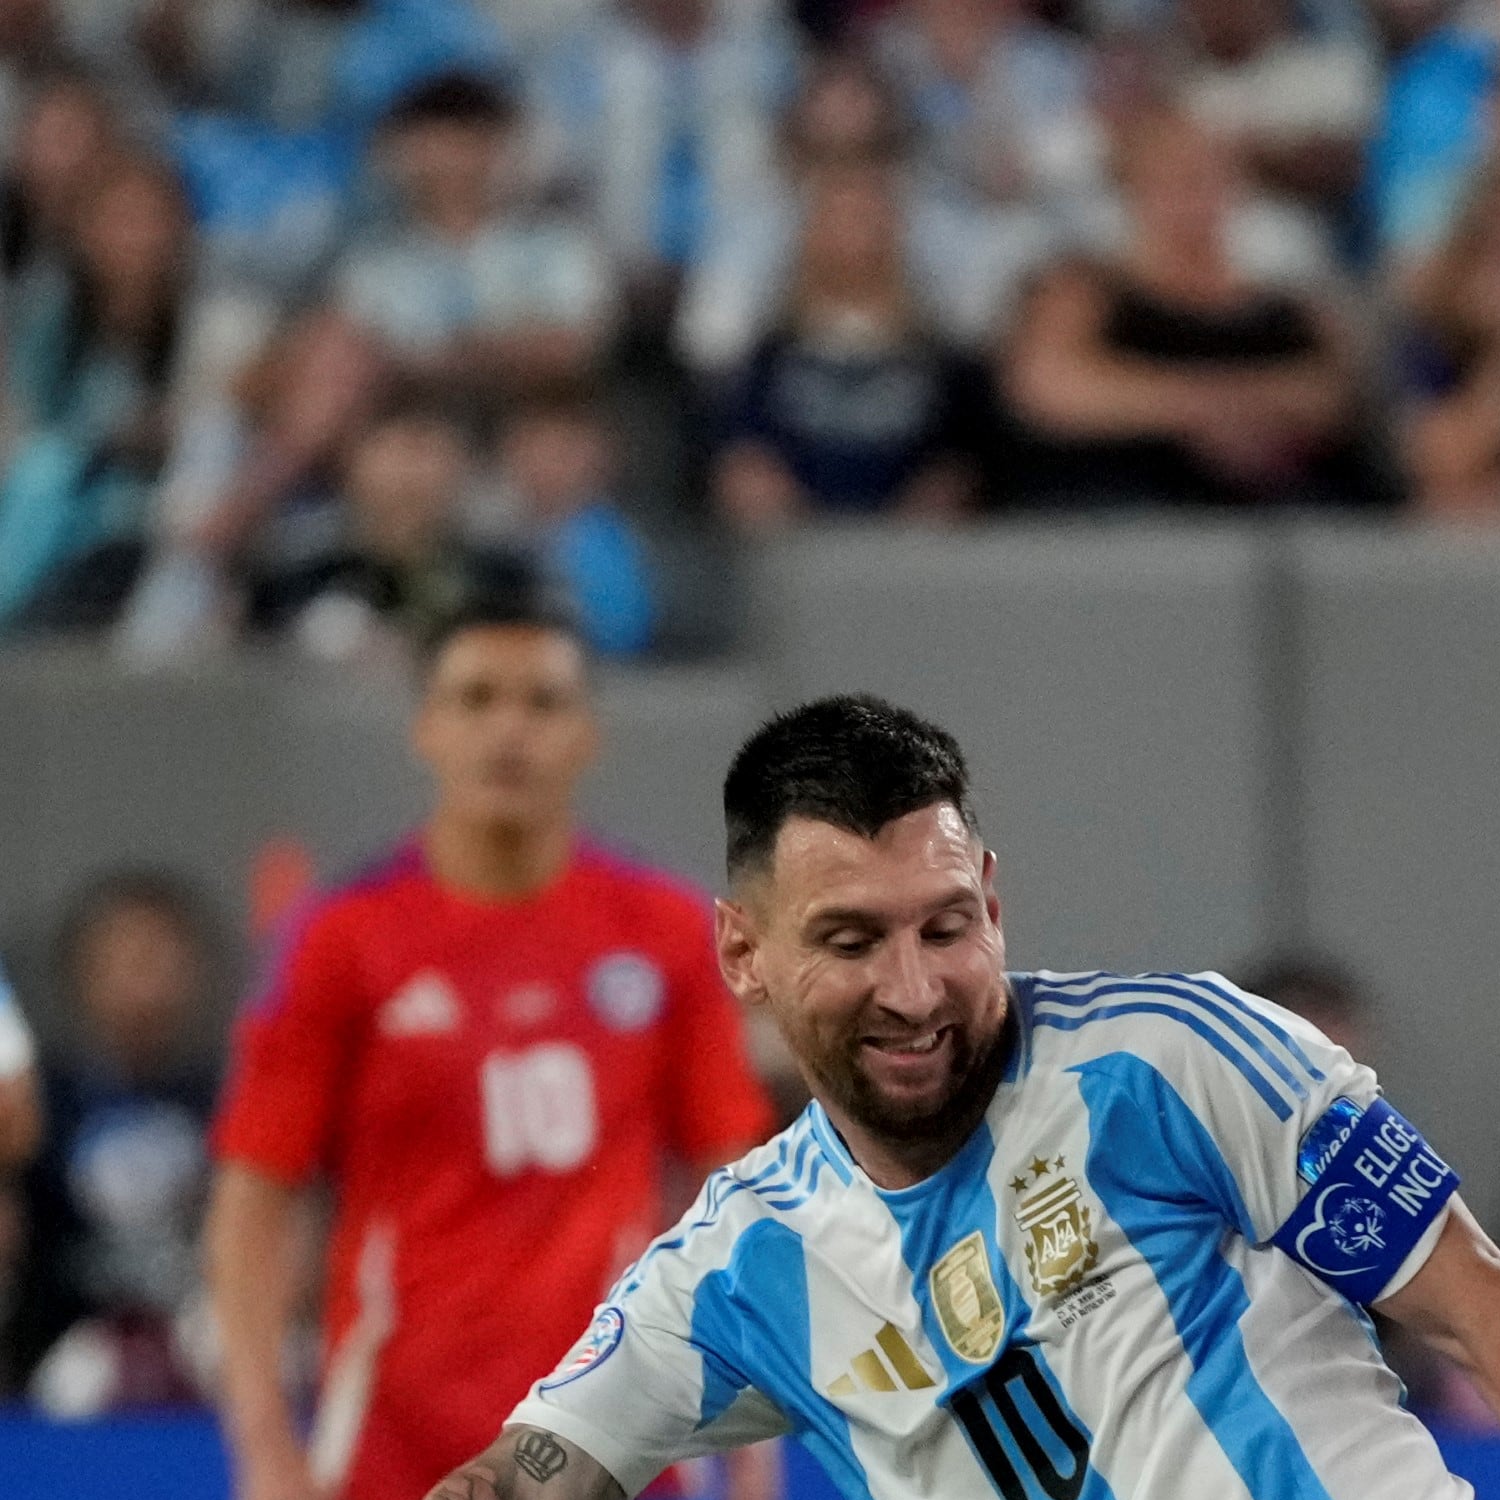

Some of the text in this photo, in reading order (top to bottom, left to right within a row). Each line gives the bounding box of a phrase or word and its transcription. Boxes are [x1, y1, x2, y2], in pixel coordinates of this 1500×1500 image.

[480, 1040, 597, 1178] 10
[1353, 1114, 1419, 1189] ELIGE
[1387, 1143, 1451, 1217] INCL
[1040, 1210, 1079, 1264] AFA
